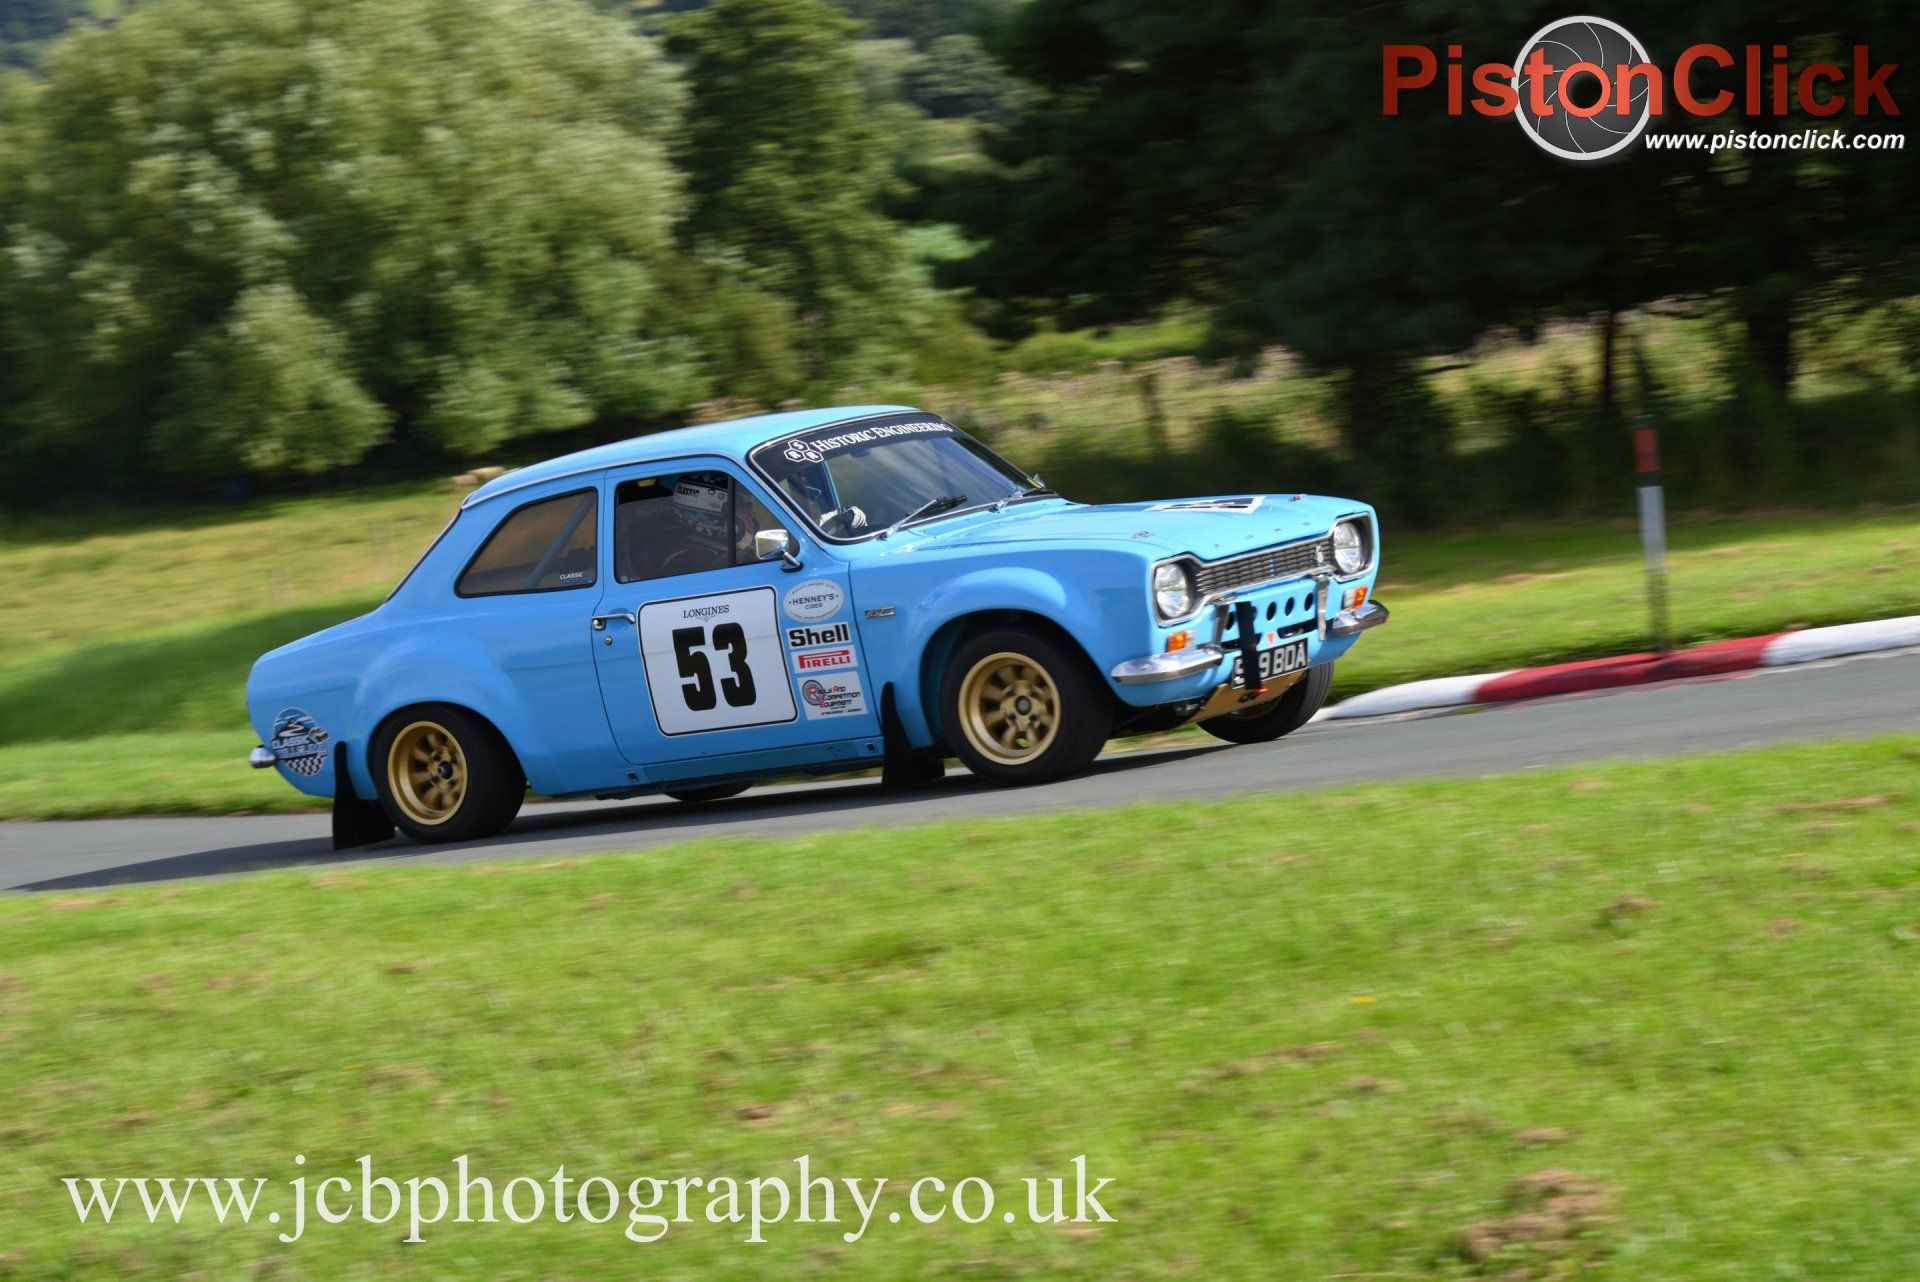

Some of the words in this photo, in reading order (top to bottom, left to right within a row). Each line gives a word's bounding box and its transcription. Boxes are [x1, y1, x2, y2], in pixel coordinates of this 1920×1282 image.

[810, 430, 877, 452] HISTORIC
[872, 422, 954, 438] ENGINEERING
[792, 594, 835, 605] HENNEY'S
[683, 605, 730, 619] LONGINES
[789, 623, 849, 647] Shell
[672, 622, 757, 712] 53
[798, 650, 851, 669] PIRELLI
[1272, 641, 1307, 676] BDA
